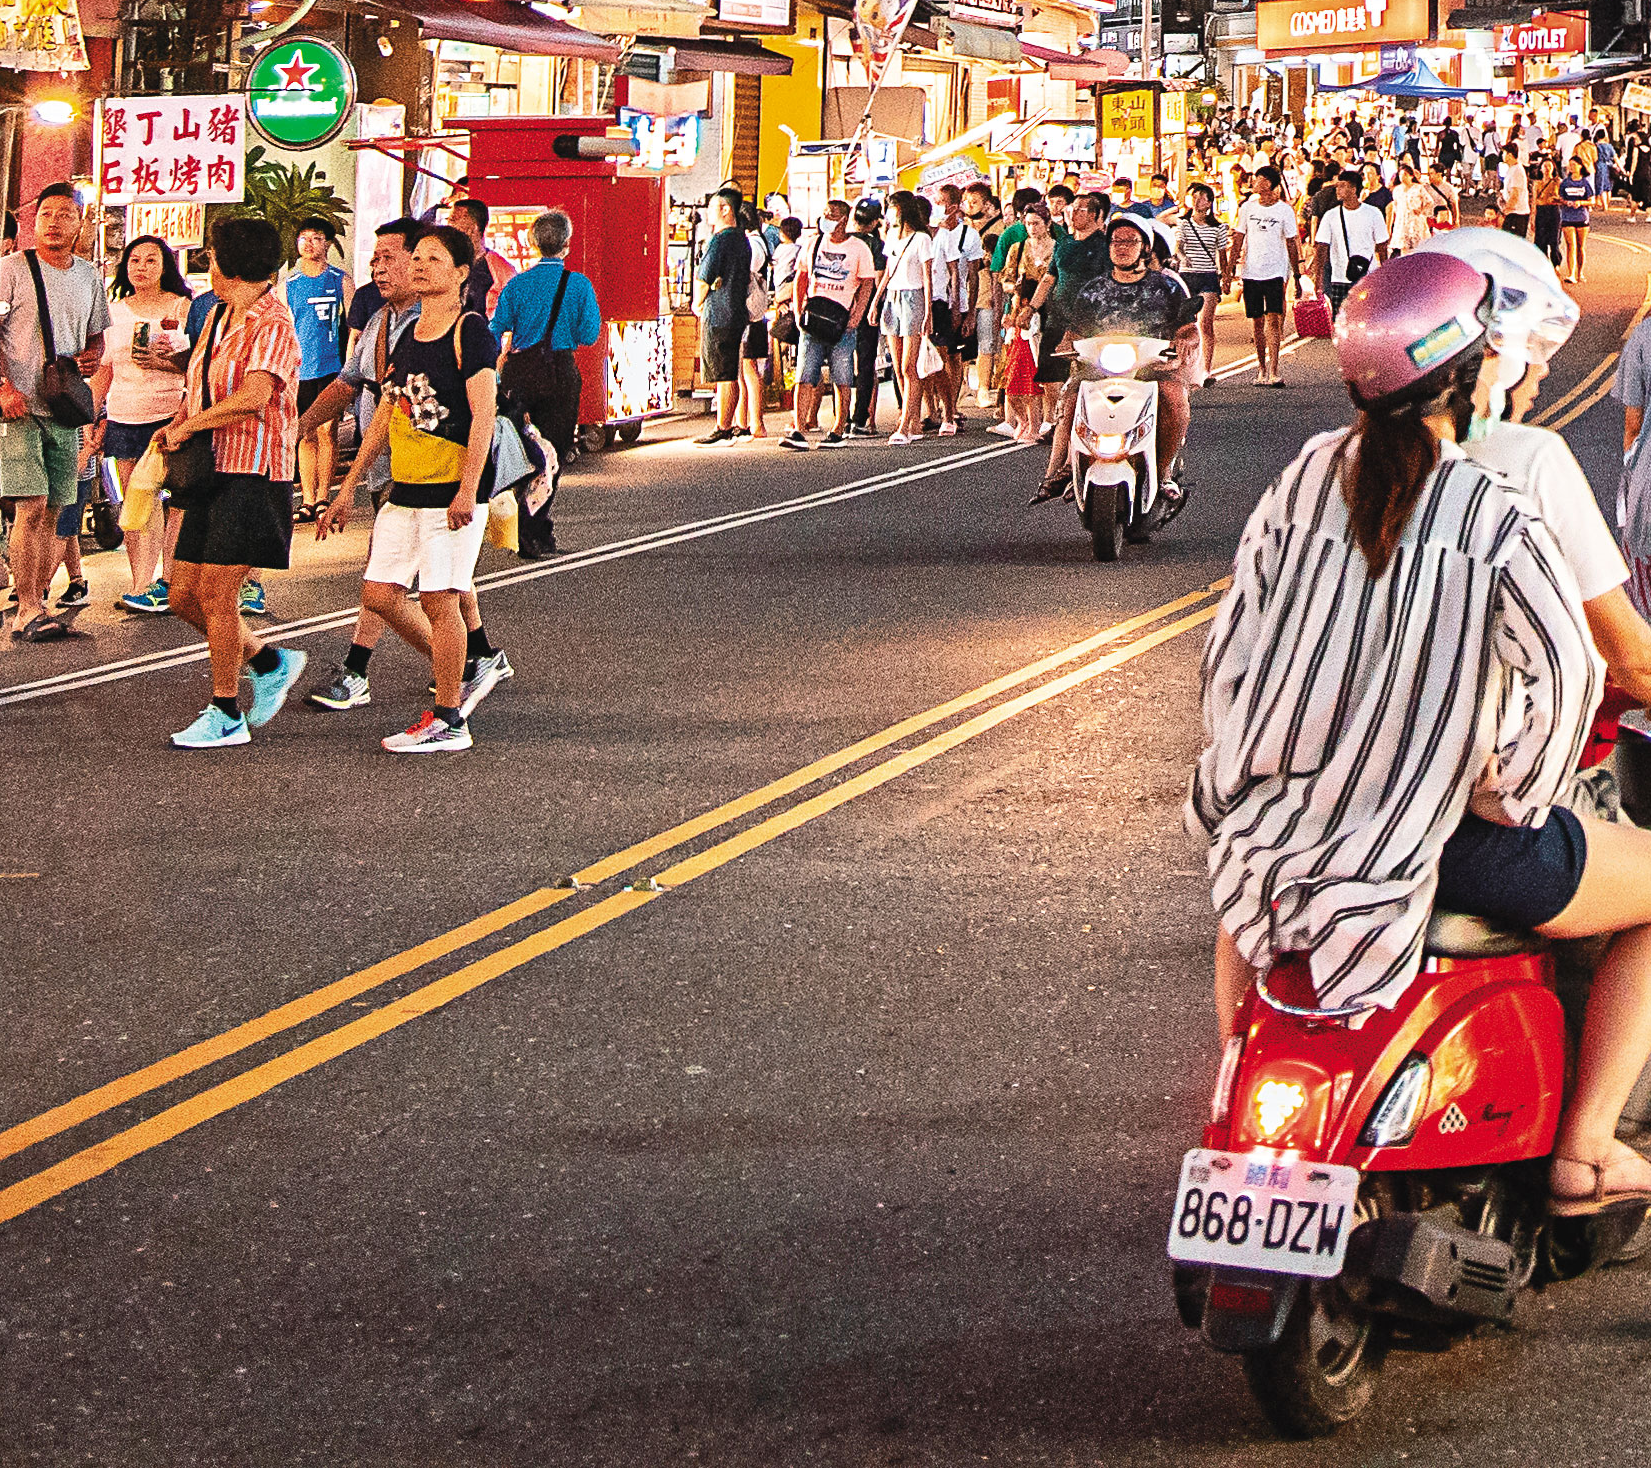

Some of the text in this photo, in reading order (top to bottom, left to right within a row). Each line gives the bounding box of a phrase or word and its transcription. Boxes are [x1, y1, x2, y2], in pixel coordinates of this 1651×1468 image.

[1517, 27, 1567, 51] OUTLET
[102, 104, 240, 149] 墾丁山豬
[102, 154, 236, 197] 石板烤肉
[1180, 1184, 1349, 1256] 868-DZW
